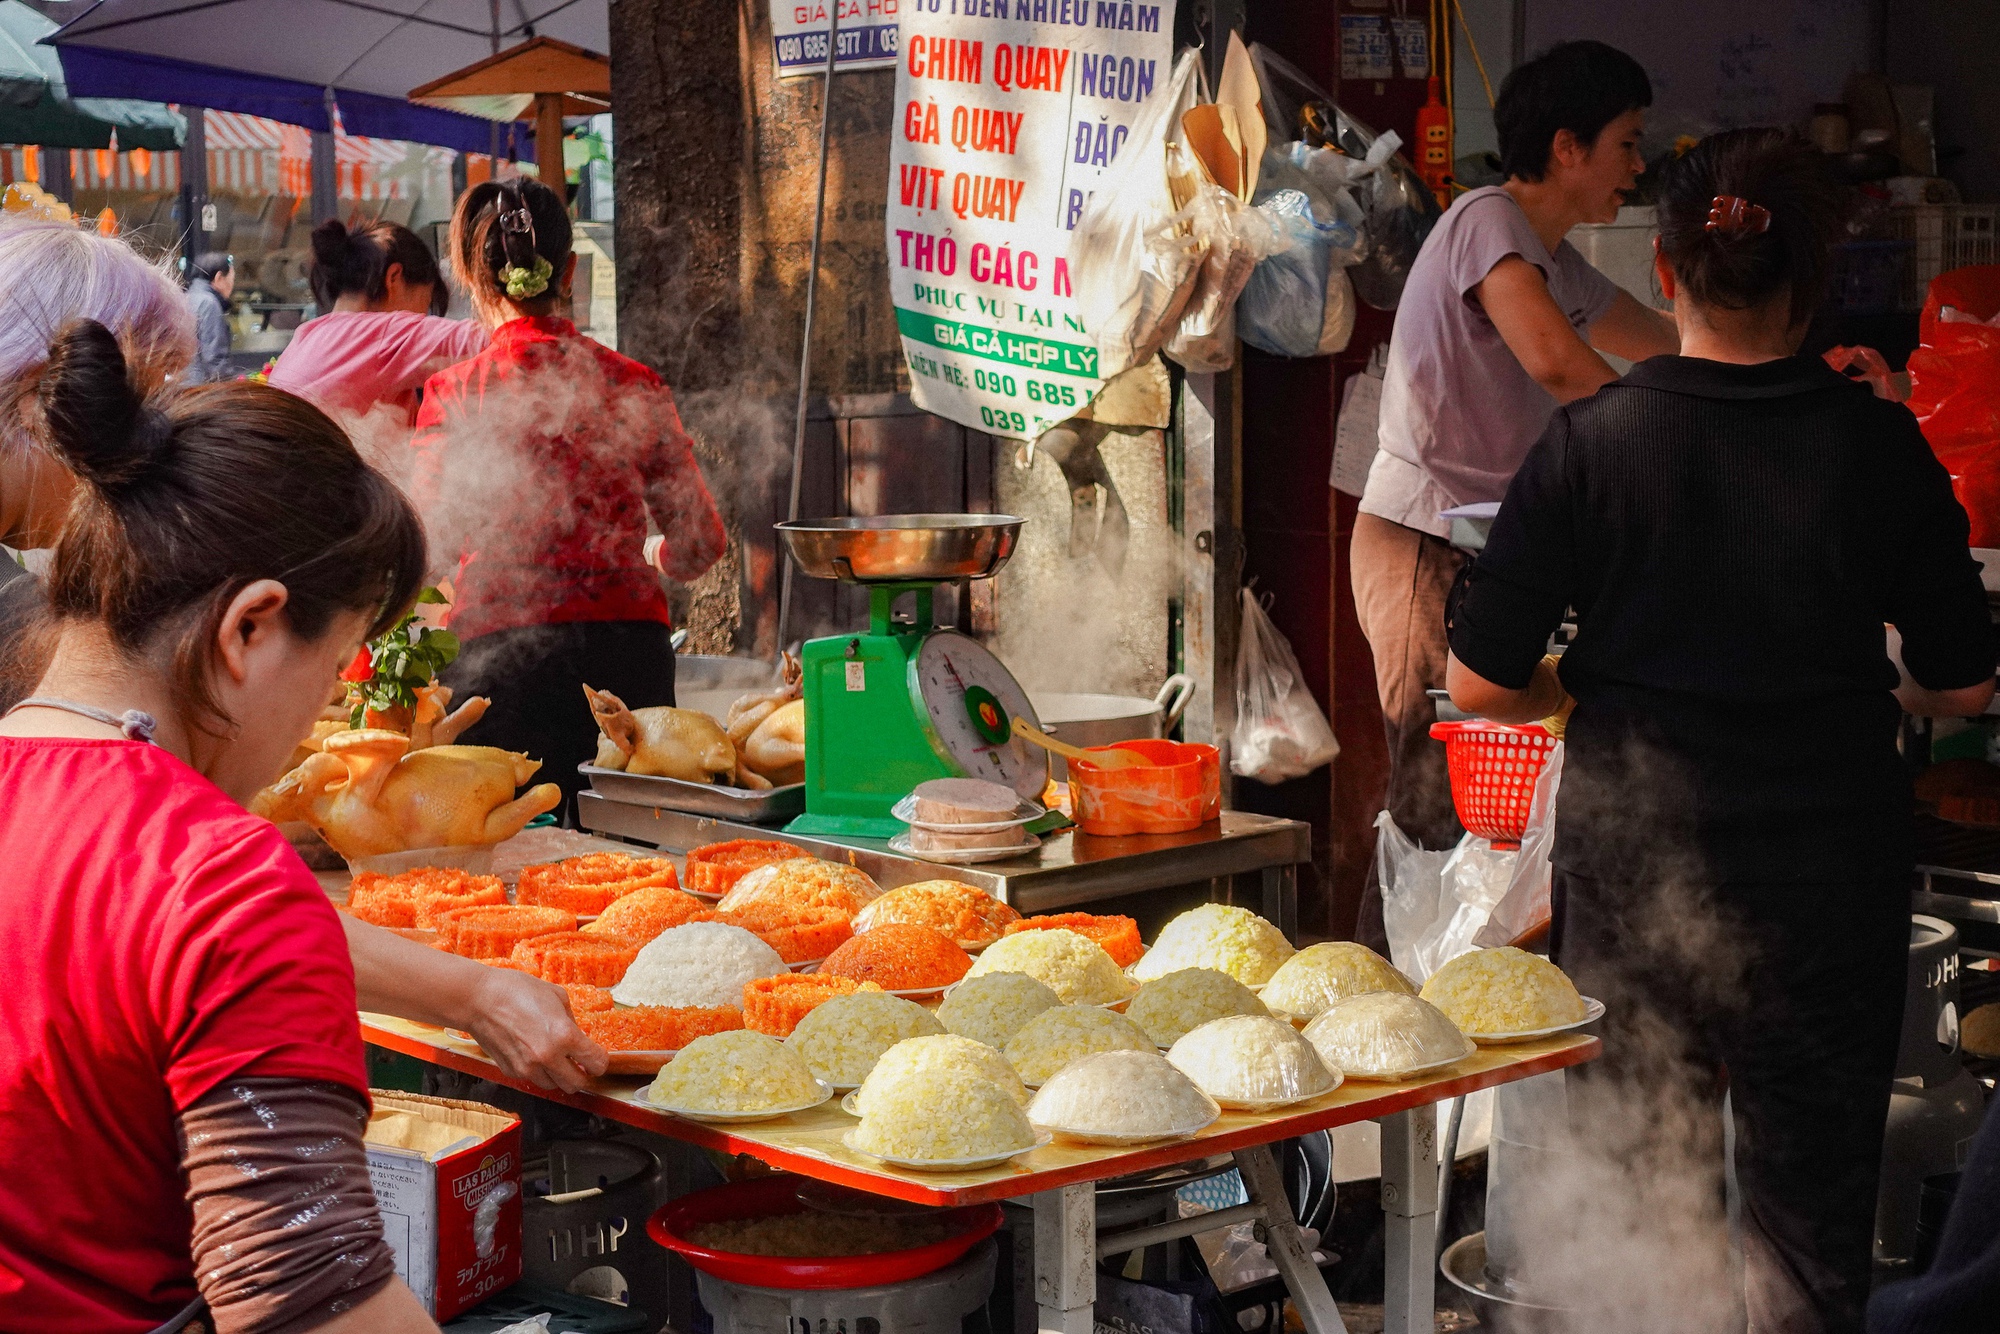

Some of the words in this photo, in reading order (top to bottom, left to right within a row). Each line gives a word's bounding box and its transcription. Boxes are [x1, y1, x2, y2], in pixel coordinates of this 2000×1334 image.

[778, 36, 802, 61] 090
[880, 27, 898, 52] 03
[908, 34, 984, 84] CHIM
[994, 43, 1070, 92] QUAY
[1082, 53, 1156, 103] NGON
[904, 96, 940, 146] GÀ
[951, 105, 1025, 155] QUAY
[901, 163, 945, 217] VỊT
[952, 172, 1026, 223] QUAY
[896, 227, 957, 276] THỎ
[970, 241, 1038, 291] CÁC
[914, 283, 968, 314] PHỤC
[976, 295, 1007, 325] VỤ
[1013, 303, 1053, 331] TẠI
[934, 322, 970, 349] GIÁ
[972, 329, 1004, 357] CẢ
[1007, 338, 1060, 369] HỢP
[1063, 346, 1098, 373] LÝ
[974, 369, 1017, 398] 090
[1026, 379, 1076, 407] 685
[981, 405, 1026, 433] 039
[457, 1173, 479, 1194] LAS
[481, 1157, 508, 1184] PALMS
